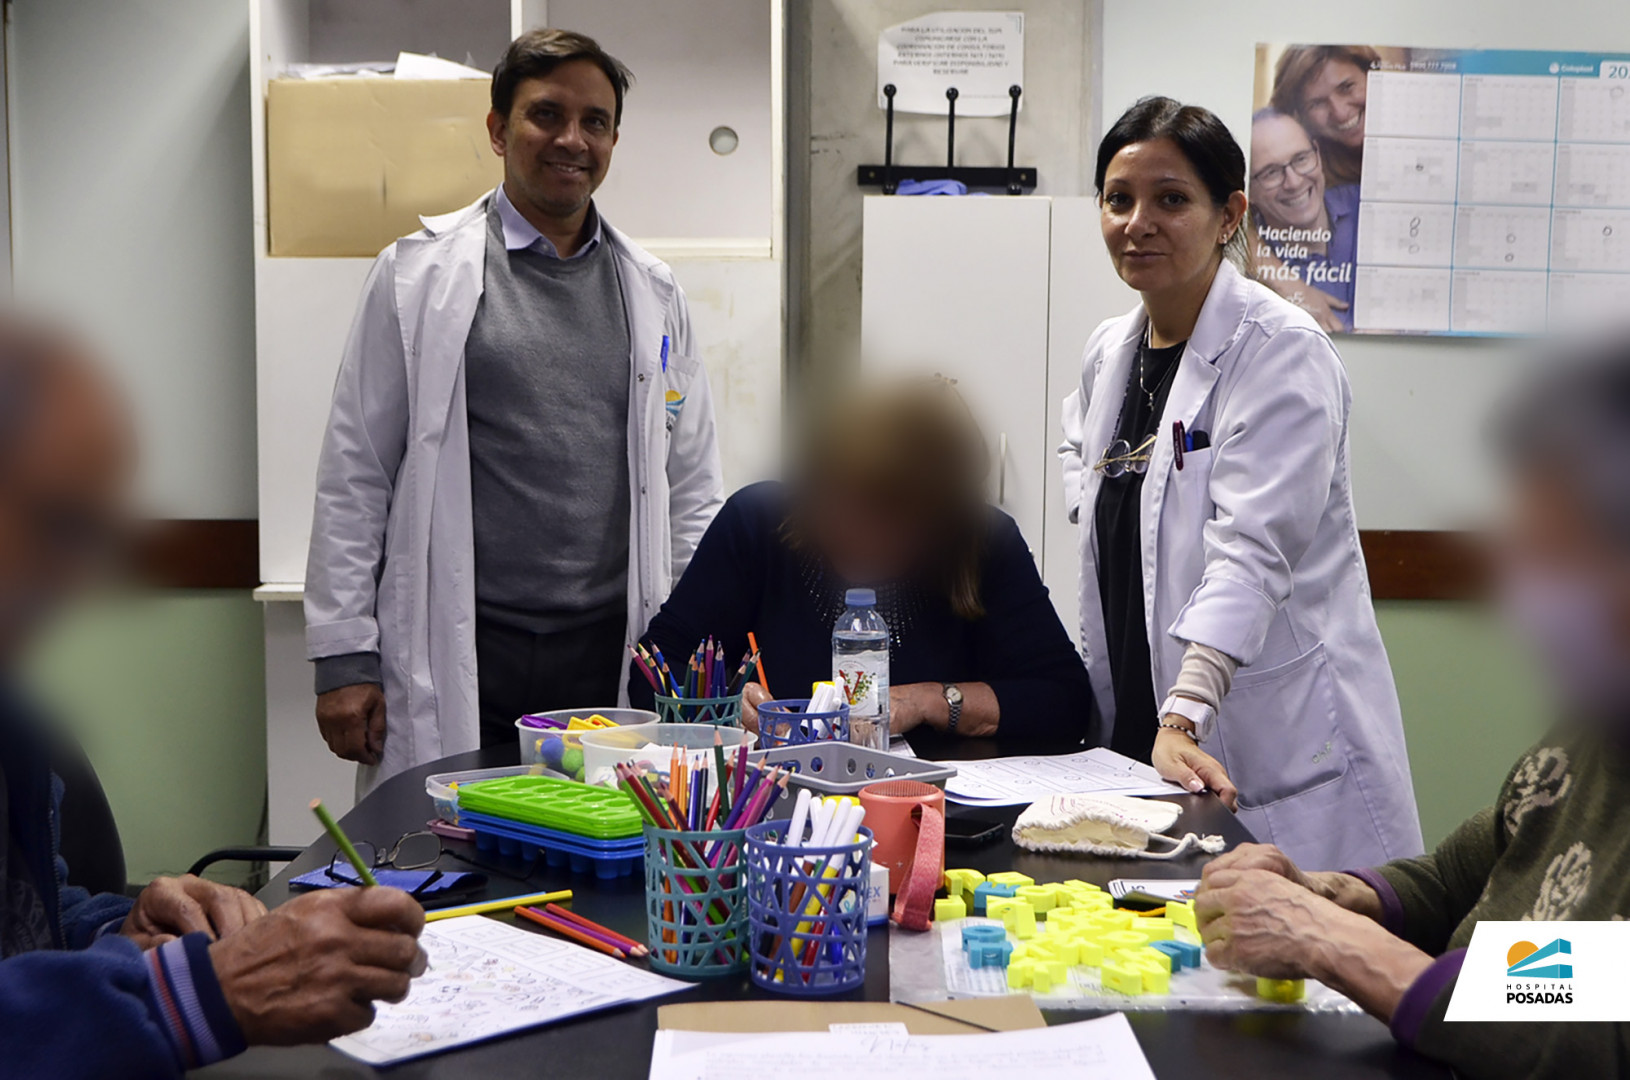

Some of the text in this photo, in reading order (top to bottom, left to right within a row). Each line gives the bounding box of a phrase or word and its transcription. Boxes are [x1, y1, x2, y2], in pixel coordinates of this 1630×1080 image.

[1608, 66, 1630, 79] 20
[1258, 225, 1332, 243] Haciendo
[1257, 243, 1308, 260] la vida
[1257, 260, 1353, 286] más fácil
